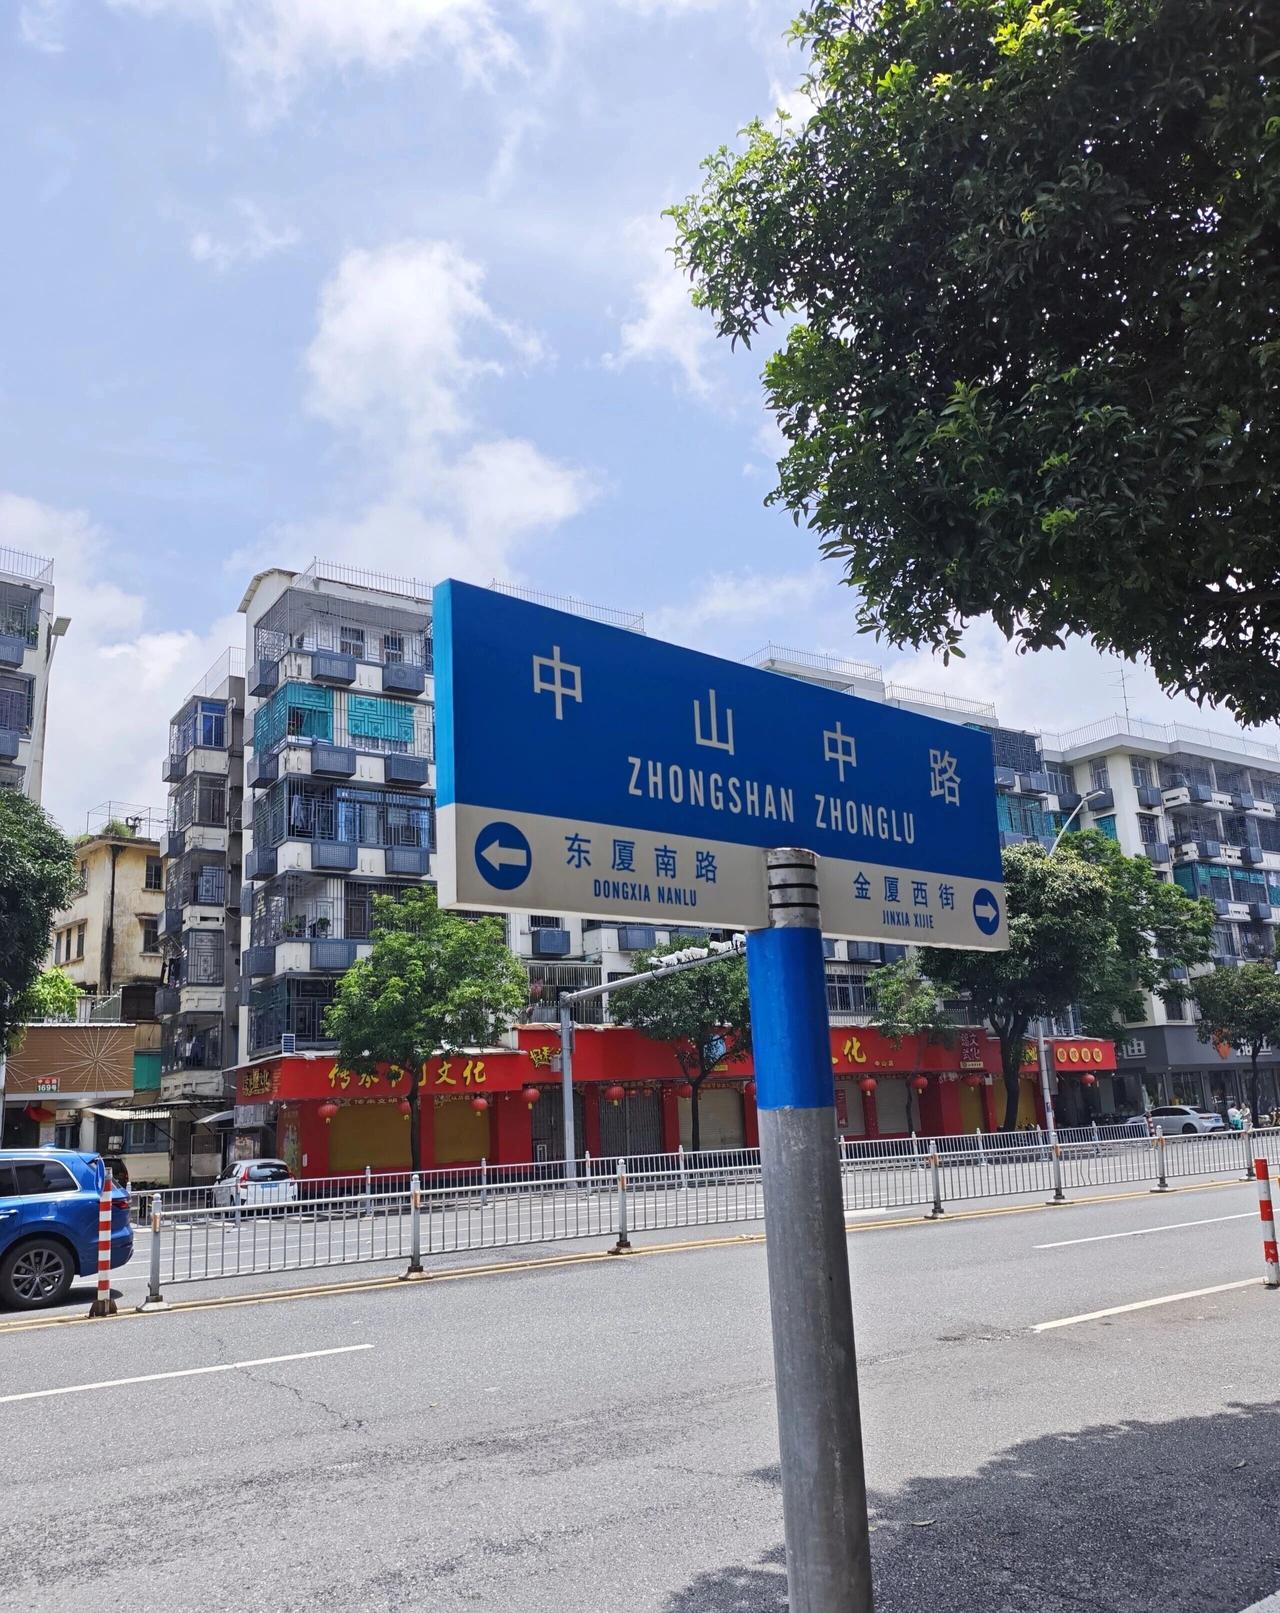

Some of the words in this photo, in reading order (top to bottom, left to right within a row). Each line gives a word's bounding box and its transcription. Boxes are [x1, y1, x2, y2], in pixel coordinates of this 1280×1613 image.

[532, 645, 962, 807] 中山中路
[627, 756, 795, 823] ZHONGSHAN
[815, 794, 916, 845] ZHONGLU
[564, 832, 719, 884] 东厦南路
[593, 879, 652, 903] DONGXIA
[657, 884, 698, 908] NANLU
[852, 871, 956, 912] 金厦西街
[882, 908, 910, 927] JINXIA
[913, 912, 935, 930] XIJIE
